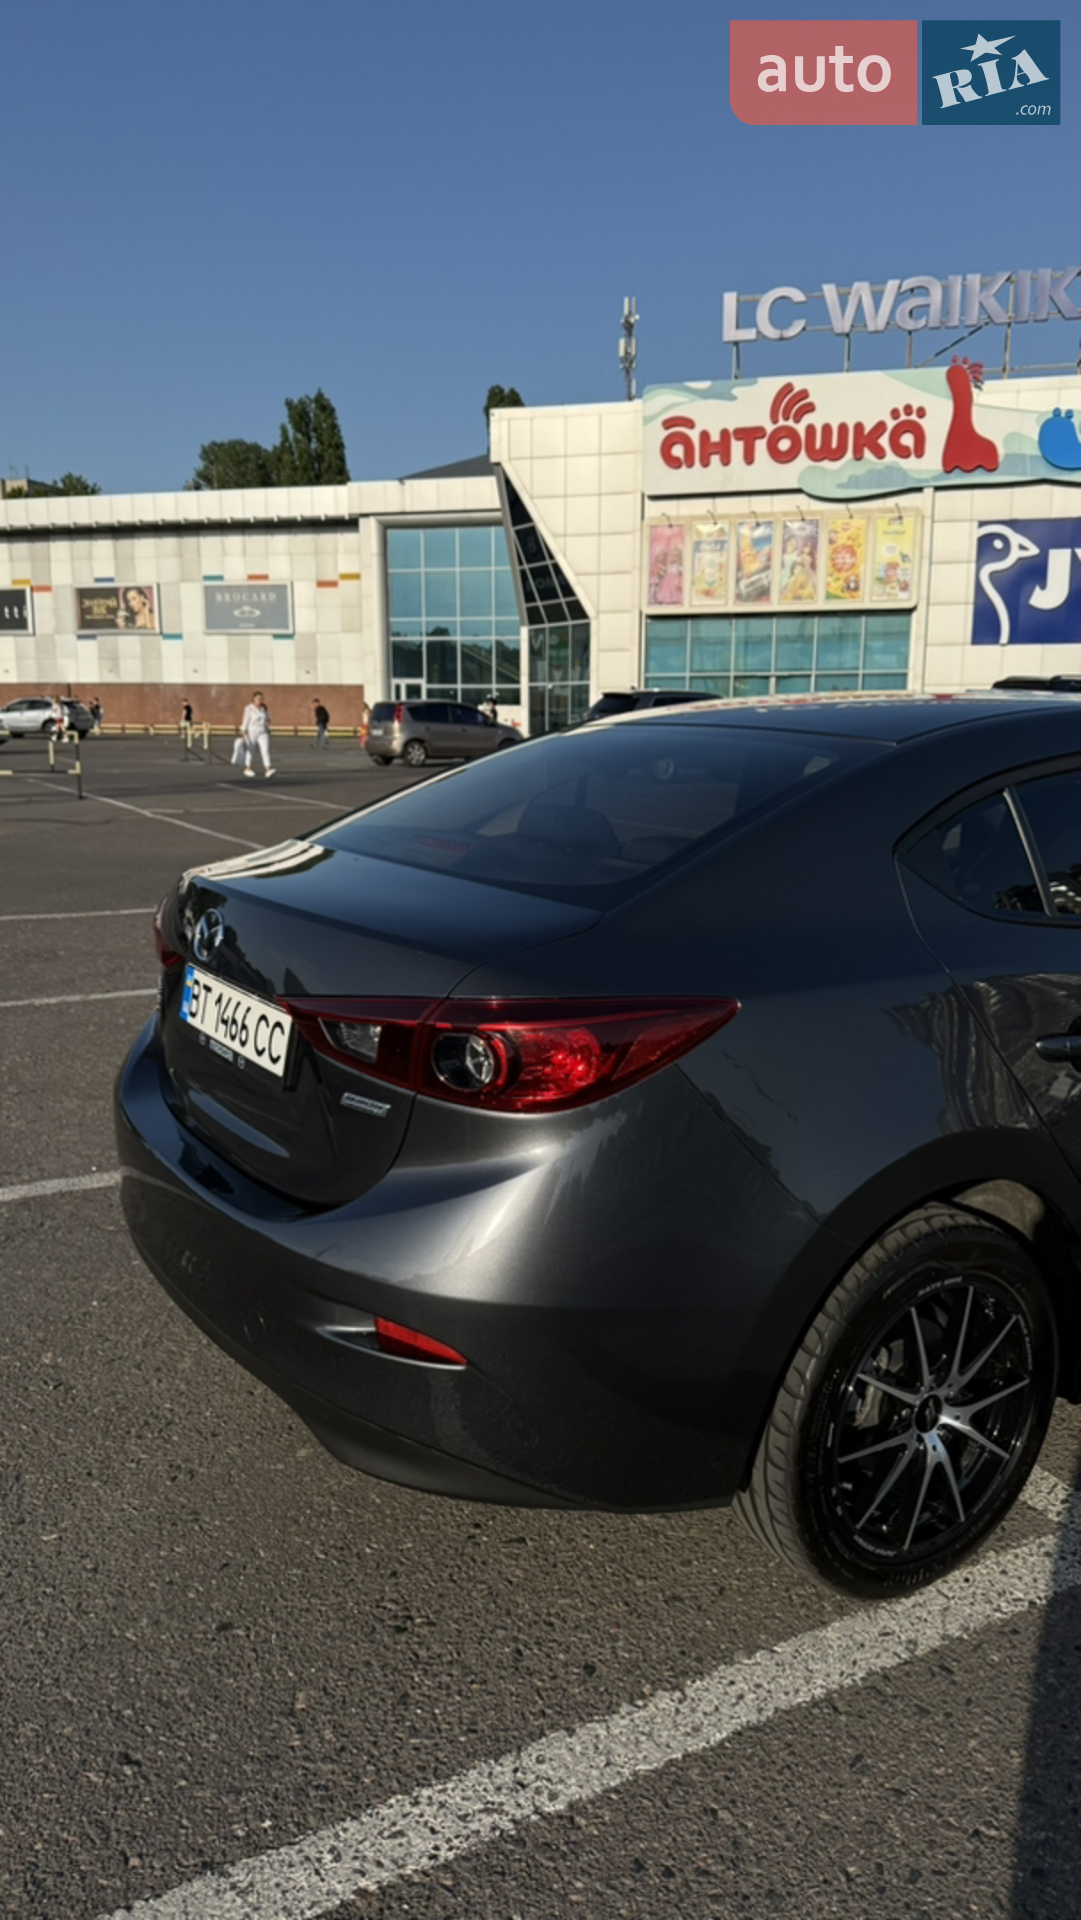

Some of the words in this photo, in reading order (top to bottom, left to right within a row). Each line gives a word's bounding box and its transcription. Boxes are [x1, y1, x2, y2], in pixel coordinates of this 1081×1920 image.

[722, 286, 807, 342] LC
[216, 591, 277, 602] BROCARD
[1028, 547, 1081, 611] J
[189, 979, 213, 1025] BT
[215, 992, 252, 1048] 1466
[254, 1013, 285, 1065] CC
